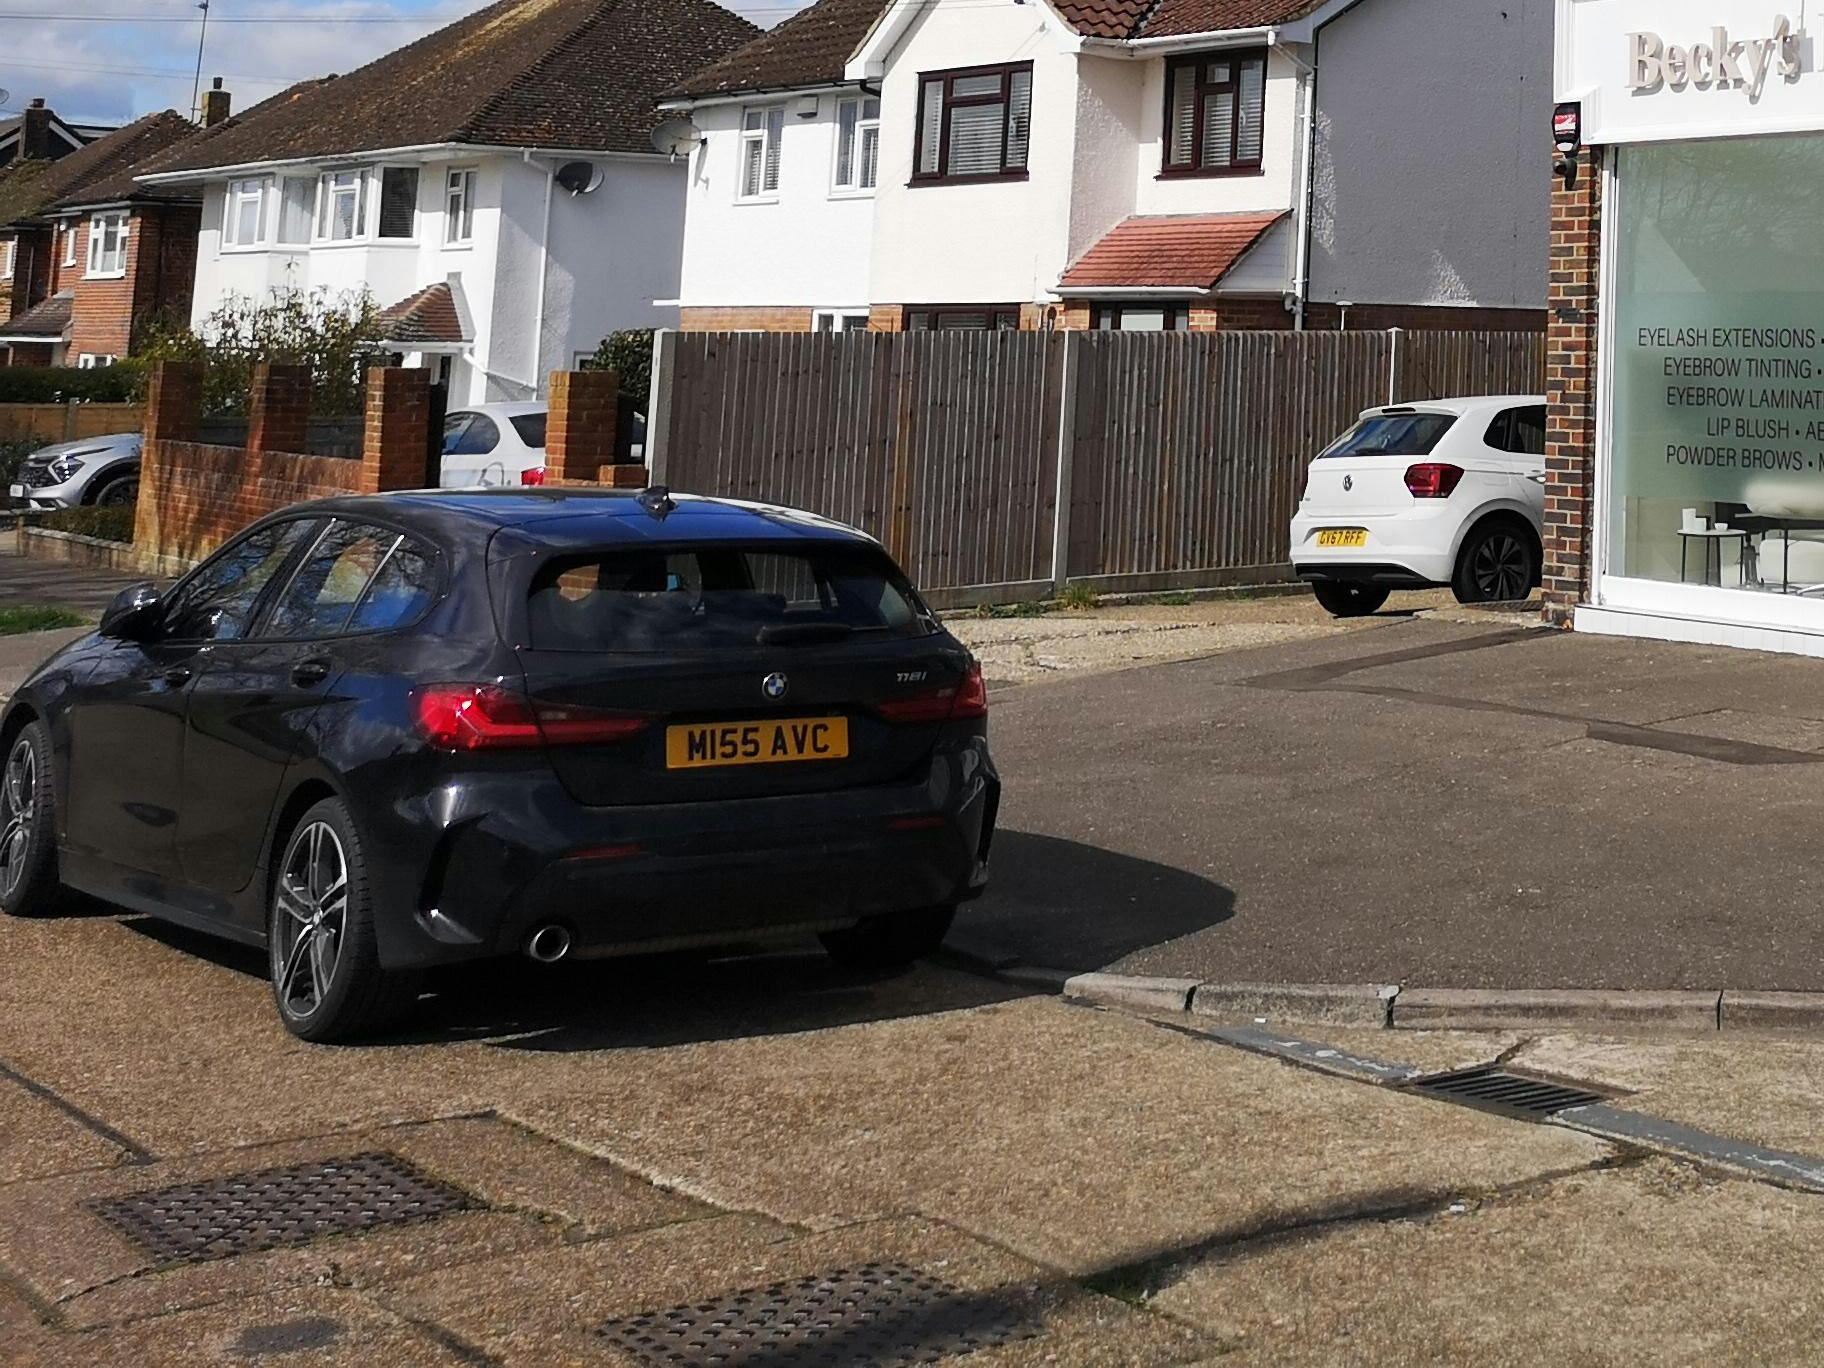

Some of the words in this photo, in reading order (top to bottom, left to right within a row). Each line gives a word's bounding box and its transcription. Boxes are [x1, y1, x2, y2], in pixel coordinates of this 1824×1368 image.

[1625, 13, 1799, 98] Becky's
[1638, 327, 1707, 347] EYELASH
[1712, 328, 1816, 348] EXTENSIONS
[1663, 357, 1742, 377] EYEBROW
[1745, 358, 1812, 379] TINTING
[1666, 386, 1745, 407] EYEBROW
[1707, 417, 1731, 436] LIP
[1736, 418, 1789, 439] BLUSH
[1666, 445, 1737, 467] POWDER
[1741, 448, 1803, 471] BROWS
[687, 726, 760, 761] M155
[770, 723, 830, 756] AVC
